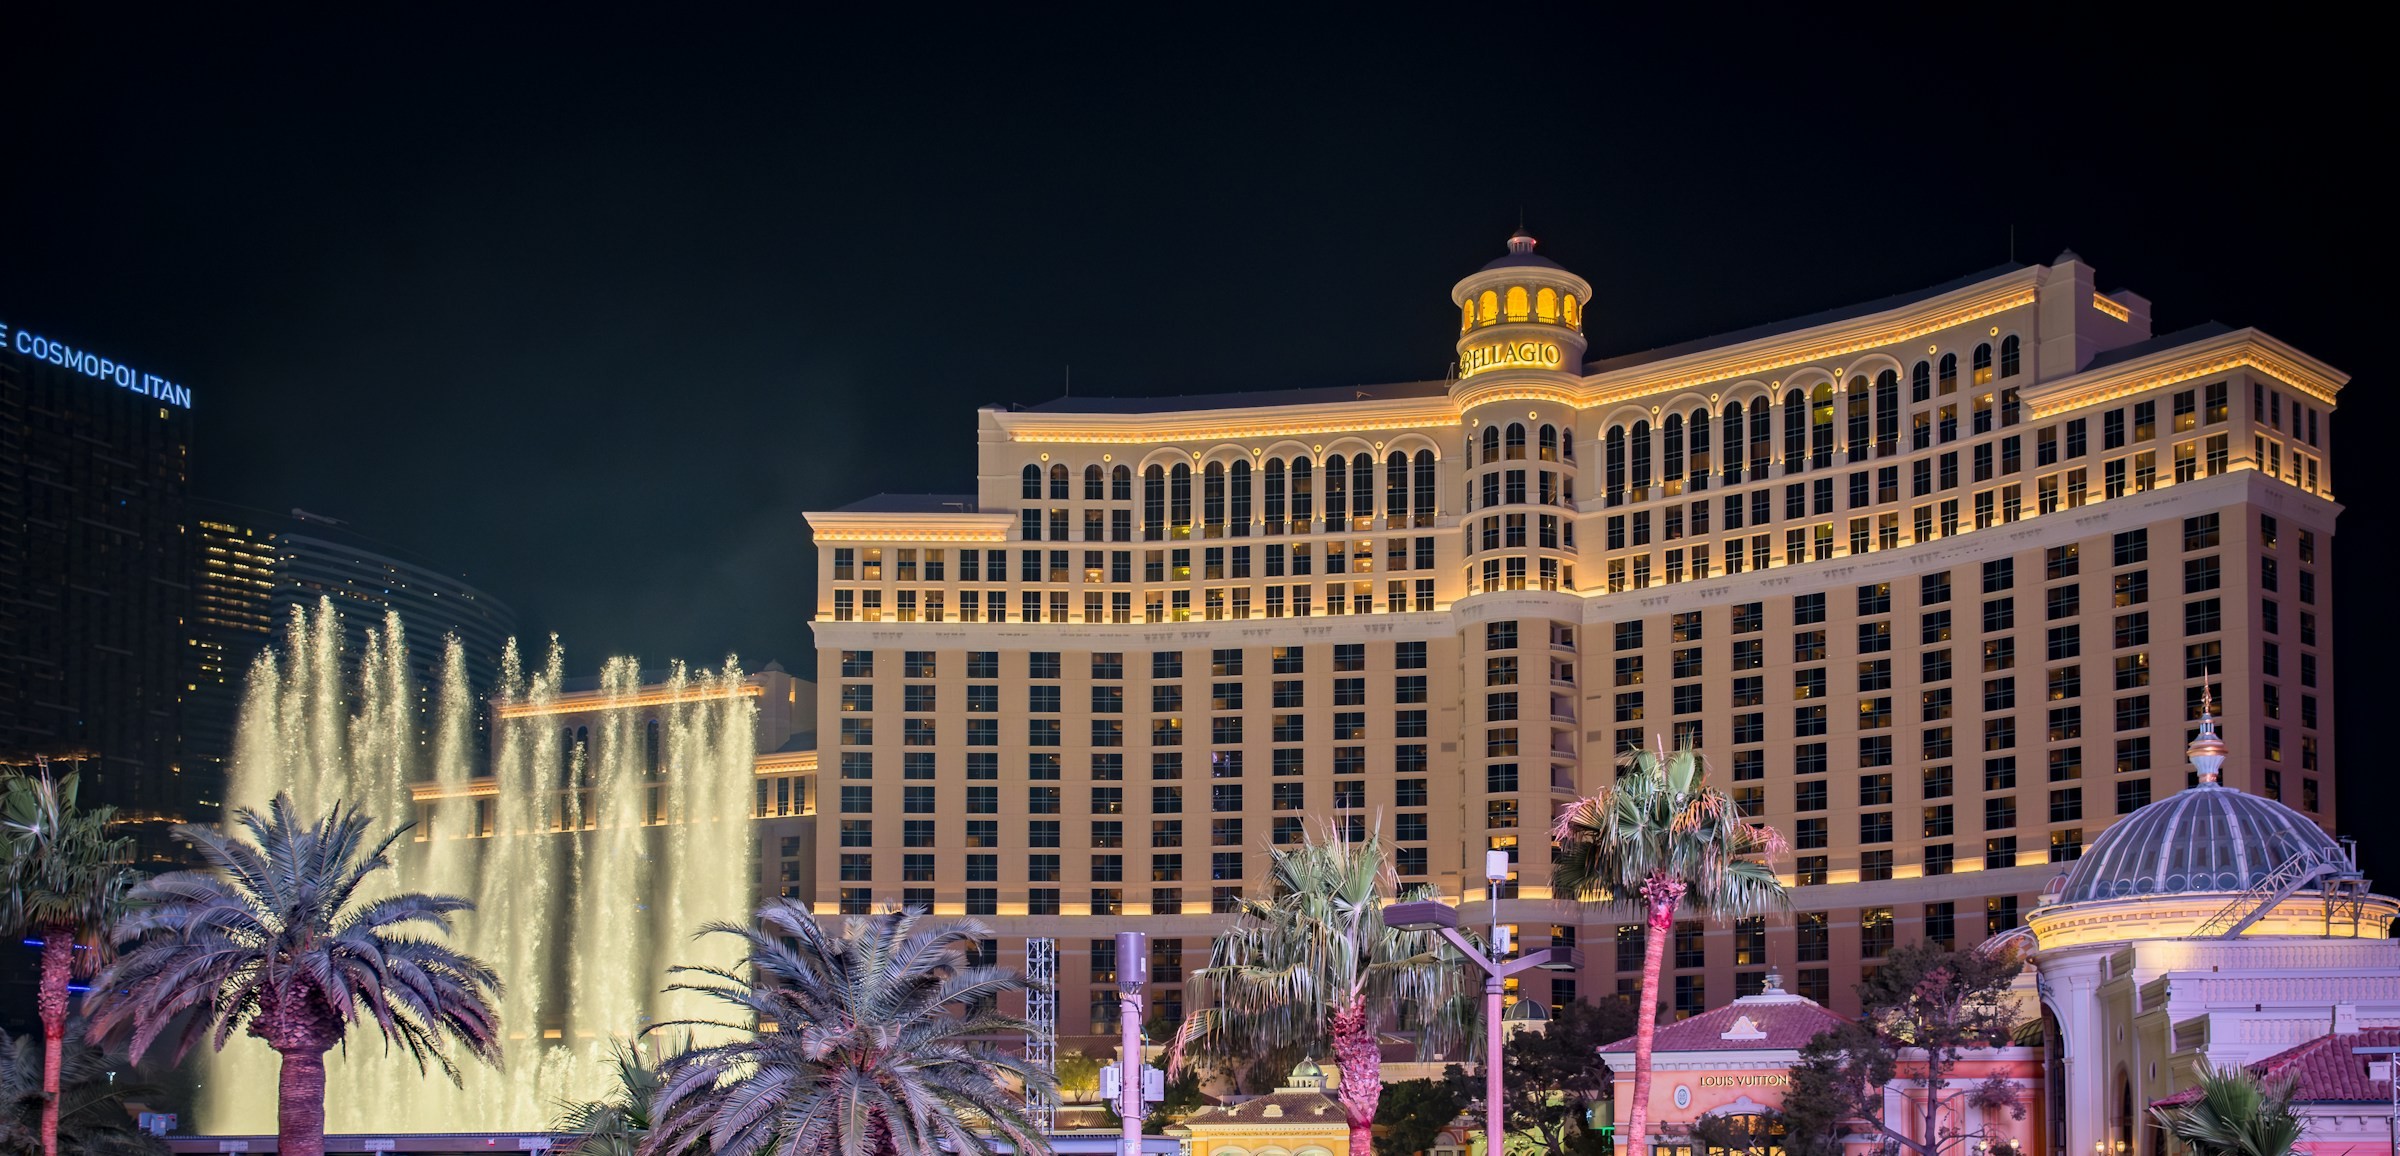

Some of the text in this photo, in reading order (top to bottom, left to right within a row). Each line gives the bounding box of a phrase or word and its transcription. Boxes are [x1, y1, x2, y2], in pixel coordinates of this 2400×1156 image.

[16, 330, 191, 409] COSMOPOLITAN
[1460, 342, 1561, 377] BELLAGIO
[1700, 1074, 1789, 1087] LOUIS VUITTON
